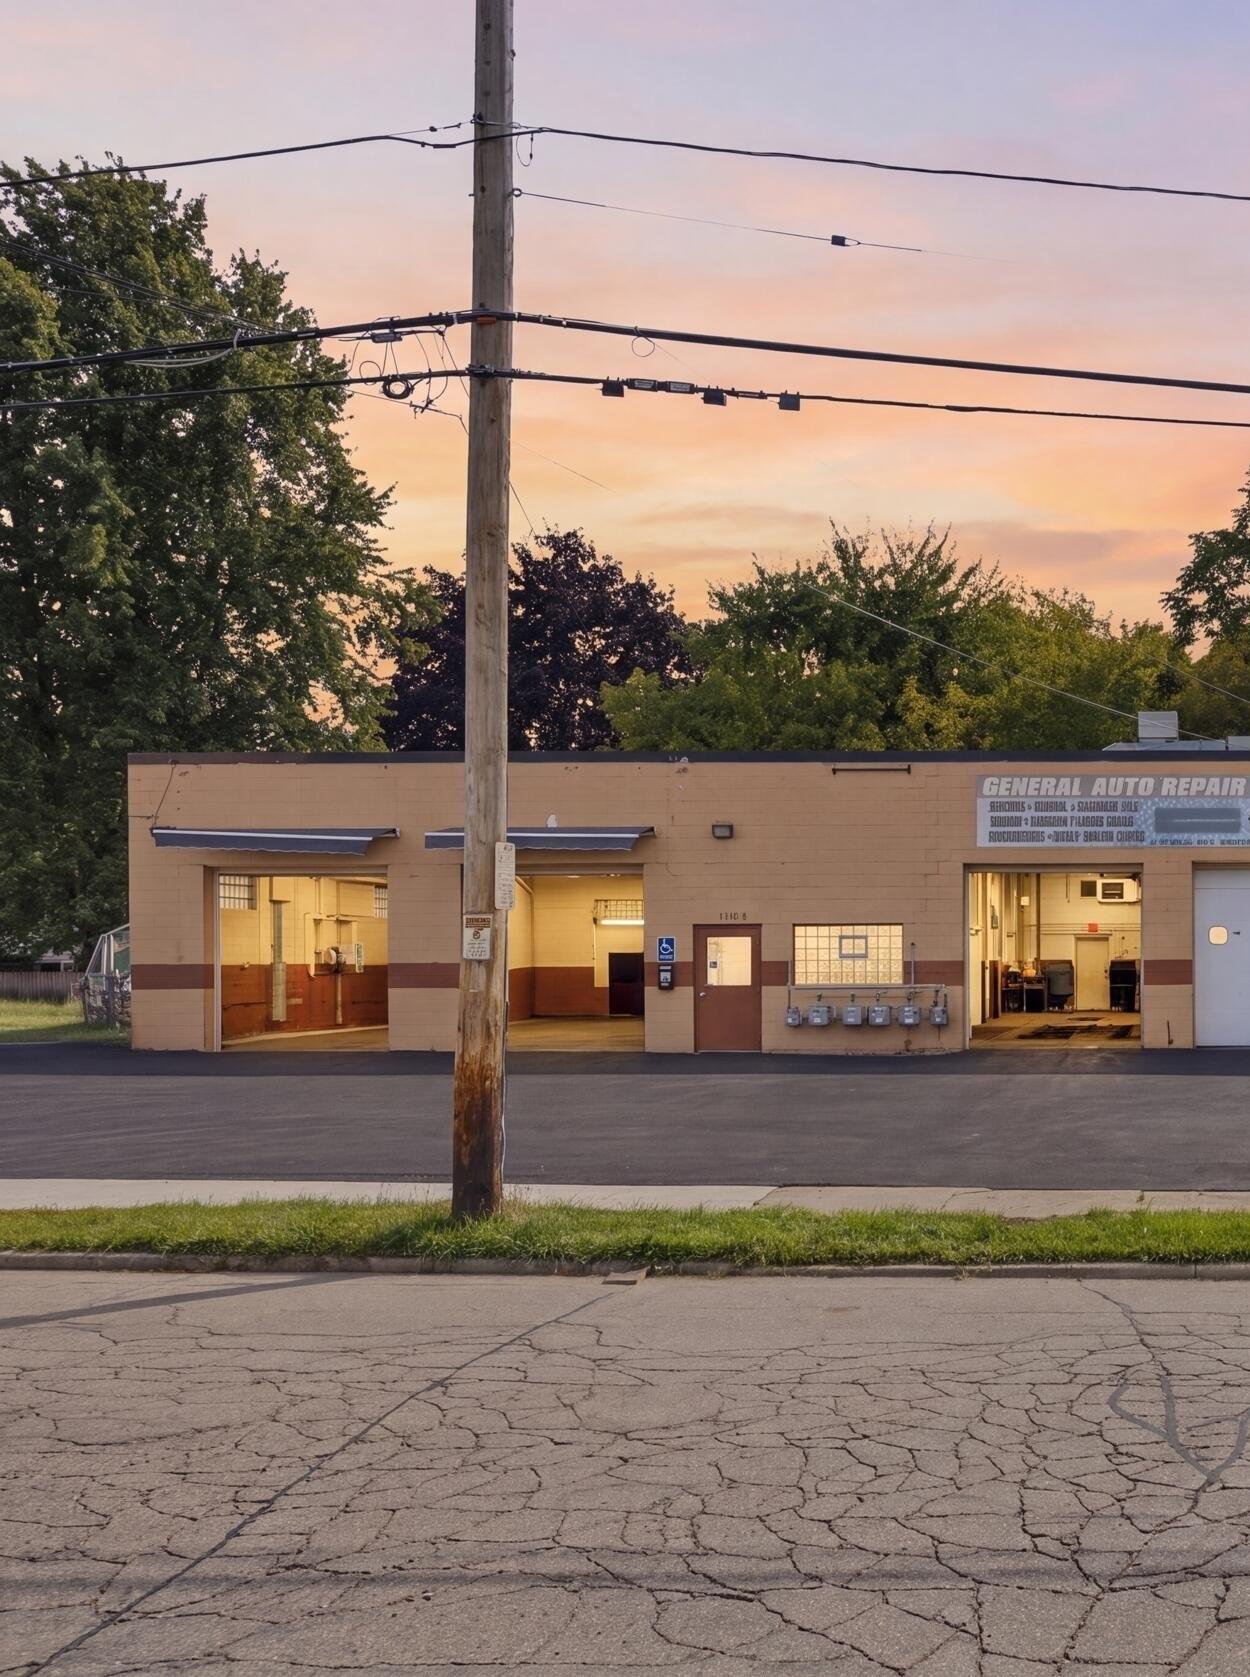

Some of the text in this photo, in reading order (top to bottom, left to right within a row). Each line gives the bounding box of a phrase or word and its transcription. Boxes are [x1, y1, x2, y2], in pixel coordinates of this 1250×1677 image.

[982, 777, 1247, 796] GENERAL AUTO REPAIR
